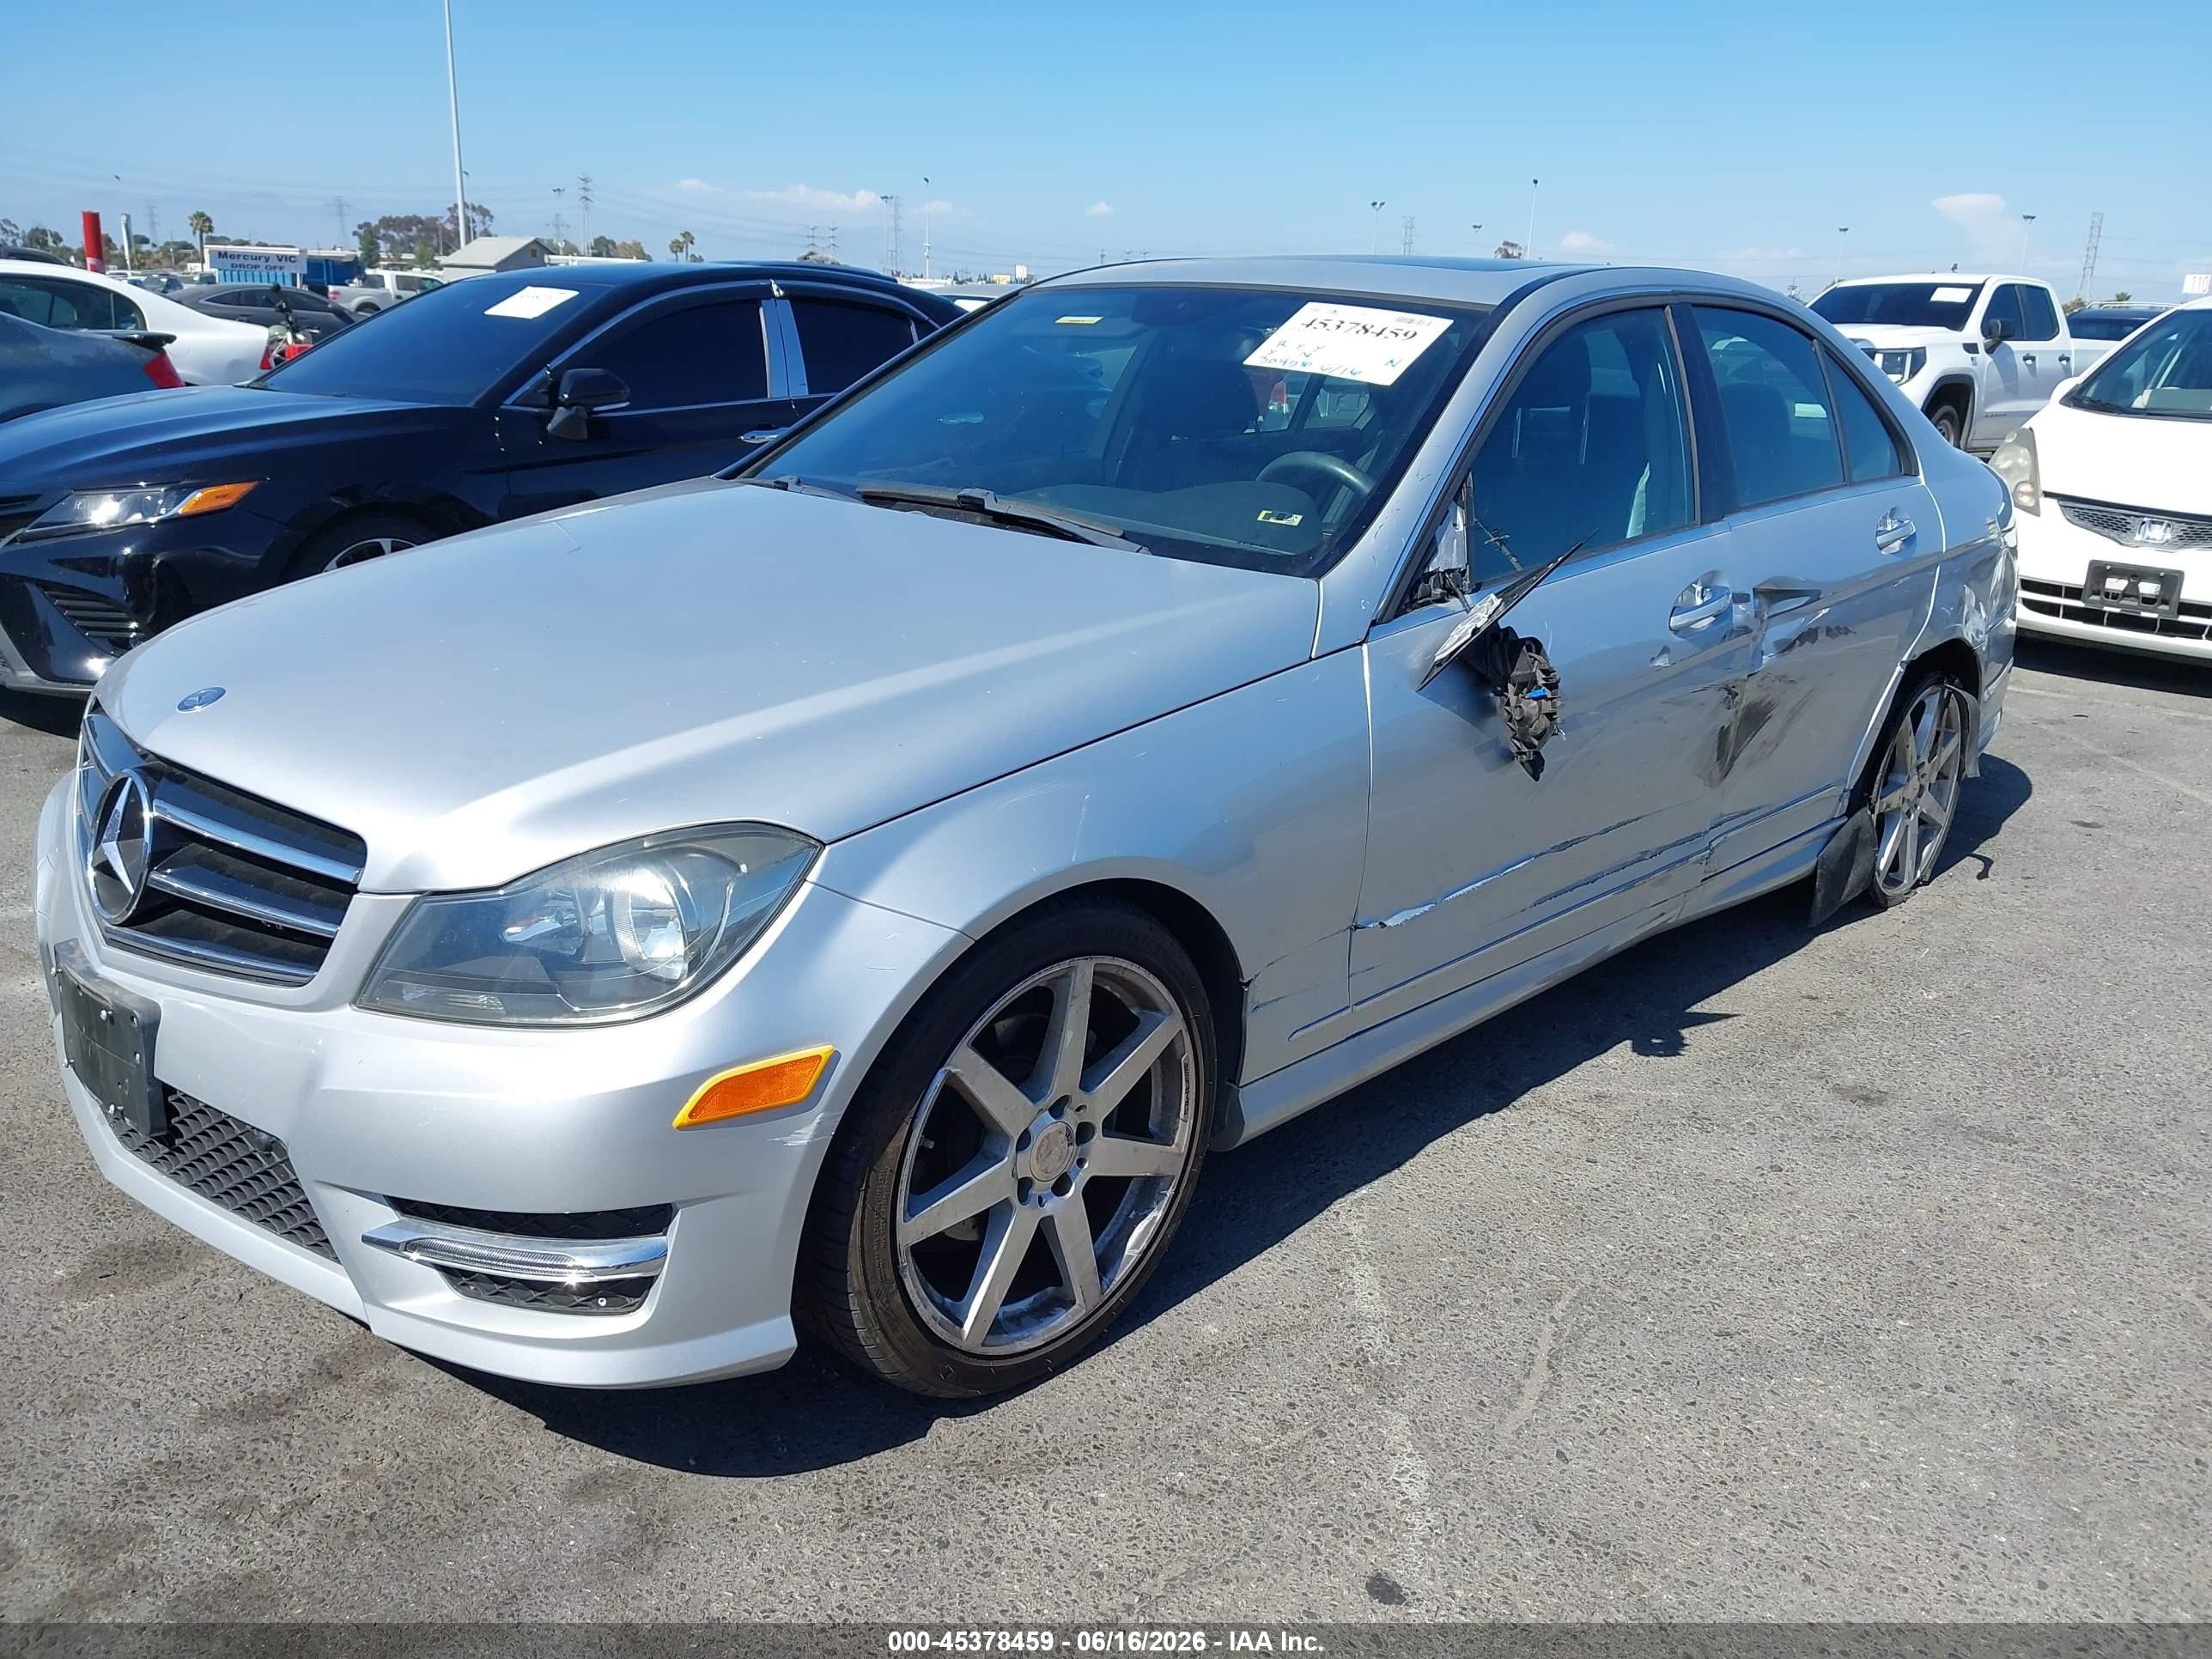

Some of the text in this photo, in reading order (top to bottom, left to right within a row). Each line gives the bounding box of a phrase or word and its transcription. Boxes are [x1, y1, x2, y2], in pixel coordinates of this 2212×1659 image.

[218, 251, 296, 263] Mercury VIC
[231, 262, 260, 270] DROP
[1301, 317, 1419, 342] 45378459
